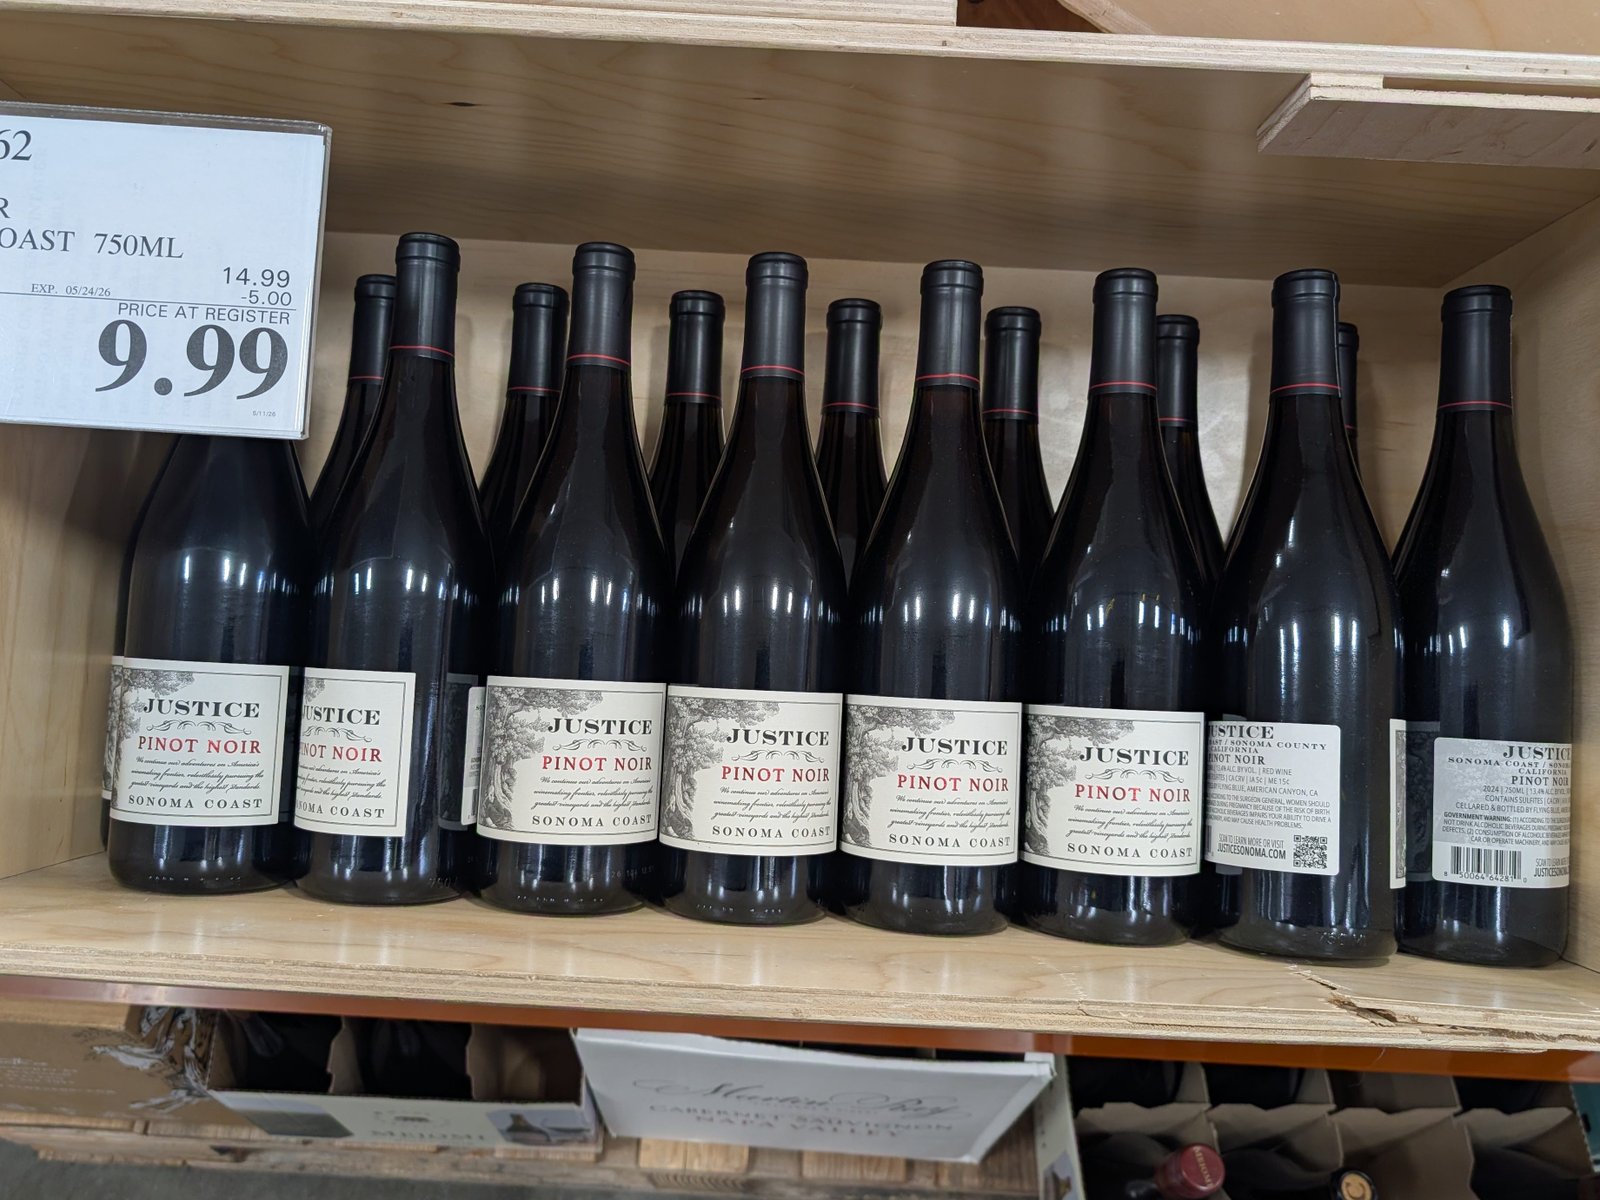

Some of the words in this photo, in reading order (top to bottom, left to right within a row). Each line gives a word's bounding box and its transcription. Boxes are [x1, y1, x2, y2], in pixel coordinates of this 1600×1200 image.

[94, 233, 184, 259] 750ML
[223, 266, 290, 288] 14.99
[31, 283, 58, 294] EXP.
[65, 285, 111, 297] 05/24/26
[241, 290, 292, 306] -5.00
[118, 303, 168, 318] PRICE
[175, 305, 199, 319] AT
[205, 307, 290, 325] REGISTER
[95, 319, 288, 400] 9.99
[143, 699, 260, 718] JUSTICE
[548, 718, 652, 735] JUSTICE
[726, 728, 829, 746] JUSTICE
[138, 736, 198, 753] PINOT
[207, 739, 261, 754] NOIR
[901, 737, 1008, 755] JUSTICE
[1230, 740, 1272, 748] SONOMA
[1277, 741, 1327, 750] COUNTY
[332, 745, 383, 762] NOIR
[1079, 747, 1189, 766] JUSTICE
[1234, 754, 1265, 765] NOIR
[542, 755, 607, 771] PINOT
[614, 757, 652, 771] NOIR
[1448, 756, 1500, 767] SONOMA
[1505, 760, 1539, 768] COAST
[721, 766, 785, 782] PINOT
[792, 768, 829, 782] NOIR
[1518, 767, 1567, 775] CALIFORNIA
[897, 774, 962, 792] PINOT
[969, 777, 1009, 792] NOIR
[1511, 776, 1549, 786] PINOT
[1552, 777, 1569, 786] NOIR
[1074, 784, 1141, 802] PINOT
[1148, 788, 1191, 802] NOIR
[1246, 786, 1277, 794] AMERICAN
[1279, 788, 1308, 796] CANYON,
[1483, 785, 1499, 793] 2024
[1505, 786, 1524, 794] 750ML
[128, 794, 194, 809] SONOMA
[204, 798, 263, 809] COAST
[1484, 794, 1518, 803] CONTAINS
[1519, 796, 1543, 804] SULFITES
[330, 806, 385, 818] COAST
[1253, 803, 1274, 811] BECAUSE
[1455, 802, 1489, 811] CELLARED
[1496, 804, 1525, 813] BOTTLED
[532, 815, 604, 827] SONOMA
[612, 814, 652, 827] COAST
[1268, 812, 1282, 820] YOUR
[1283, 813, 1303, 821] ABILITY
[1311, 815, 1326, 823] DRIVE
[1443, 811, 1483, 820] GOVERNMENT
[1484, 814, 1512, 822] WARNING:
[1274, 820, 1303, 828] PROBLEMS.
[1457, 819, 1473, 827] DRINK
[1474, 821, 1504, 829] ALCOHOLIC
[1505, 823, 1531, 831] BEVERAGES
[712, 825, 783, 838] SONOMA
[791, 826, 831, 838] COAST
[1475, 828, 1513, 837] CONSUMPTION
[889, 834, 961, 848] SONOMA
[969, 837, 1011, 848] COAST
[1228, 834, 1233, 844] TO
[1233, 835, 1247, 845] LEARN
[1247, 837, 1262, 847] MORE
[1262, 838, 1271, 848] OR
[1271, 839, 1284, 849] VISIT
[1492, 837, 1514, 845] OPERATE
[1067, 842, 1141, 858] SONOMA
[1150, 848, 1192, 858] COAST
[1217, 843, 1286, 860] JUSTICESONOMA.COM
